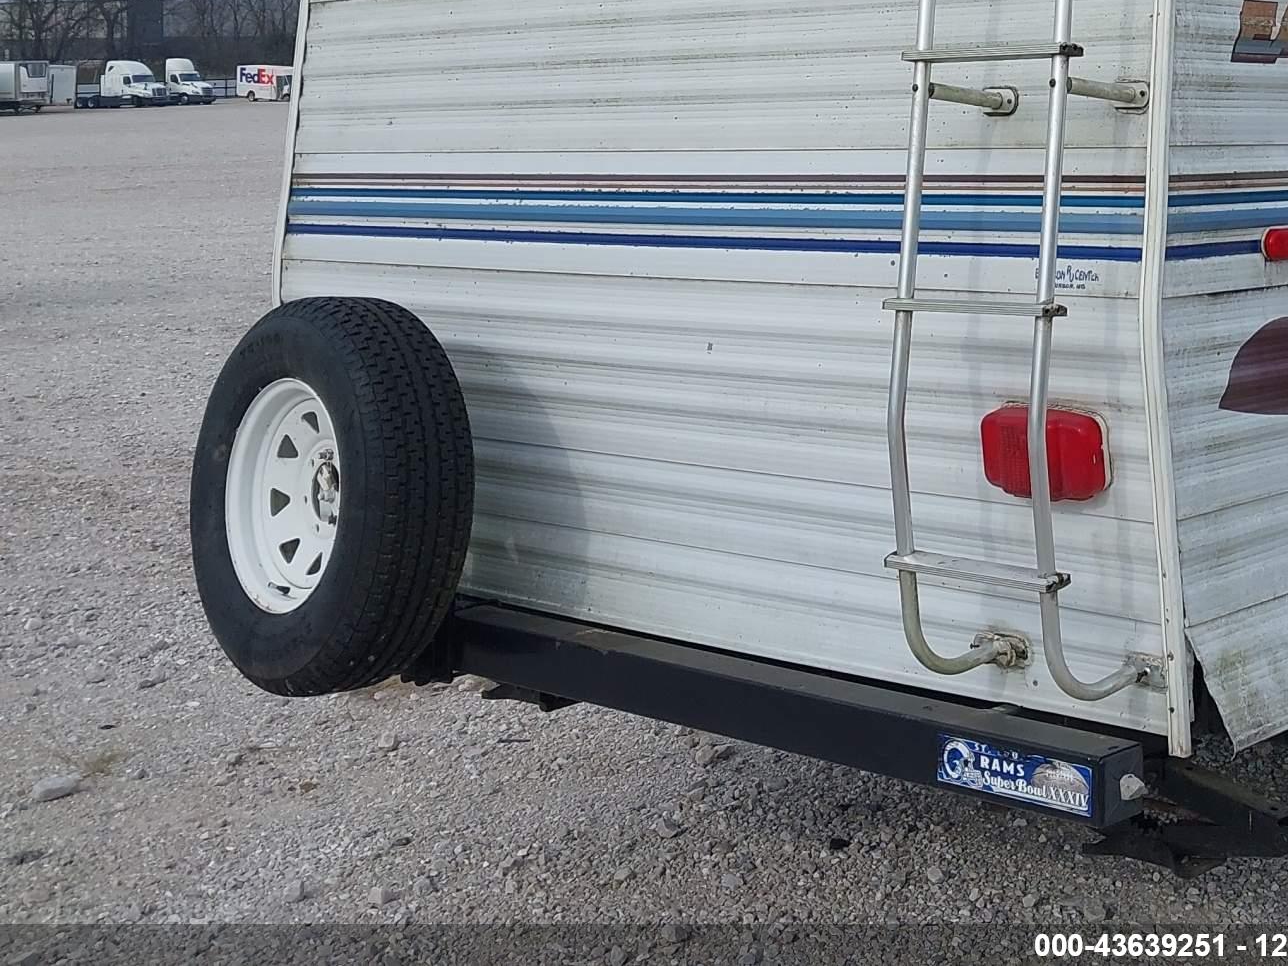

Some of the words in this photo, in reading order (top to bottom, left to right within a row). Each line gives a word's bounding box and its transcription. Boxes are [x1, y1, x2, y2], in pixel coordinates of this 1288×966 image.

[240, 67, 274, 85] FedEx
[980, 755, 1025, 777] RAMS
[982, 770, 1016, 790] Super
[1015, 778, 1047, 799] Bowl
[1047, 786, 1090, 808] XXXIV
